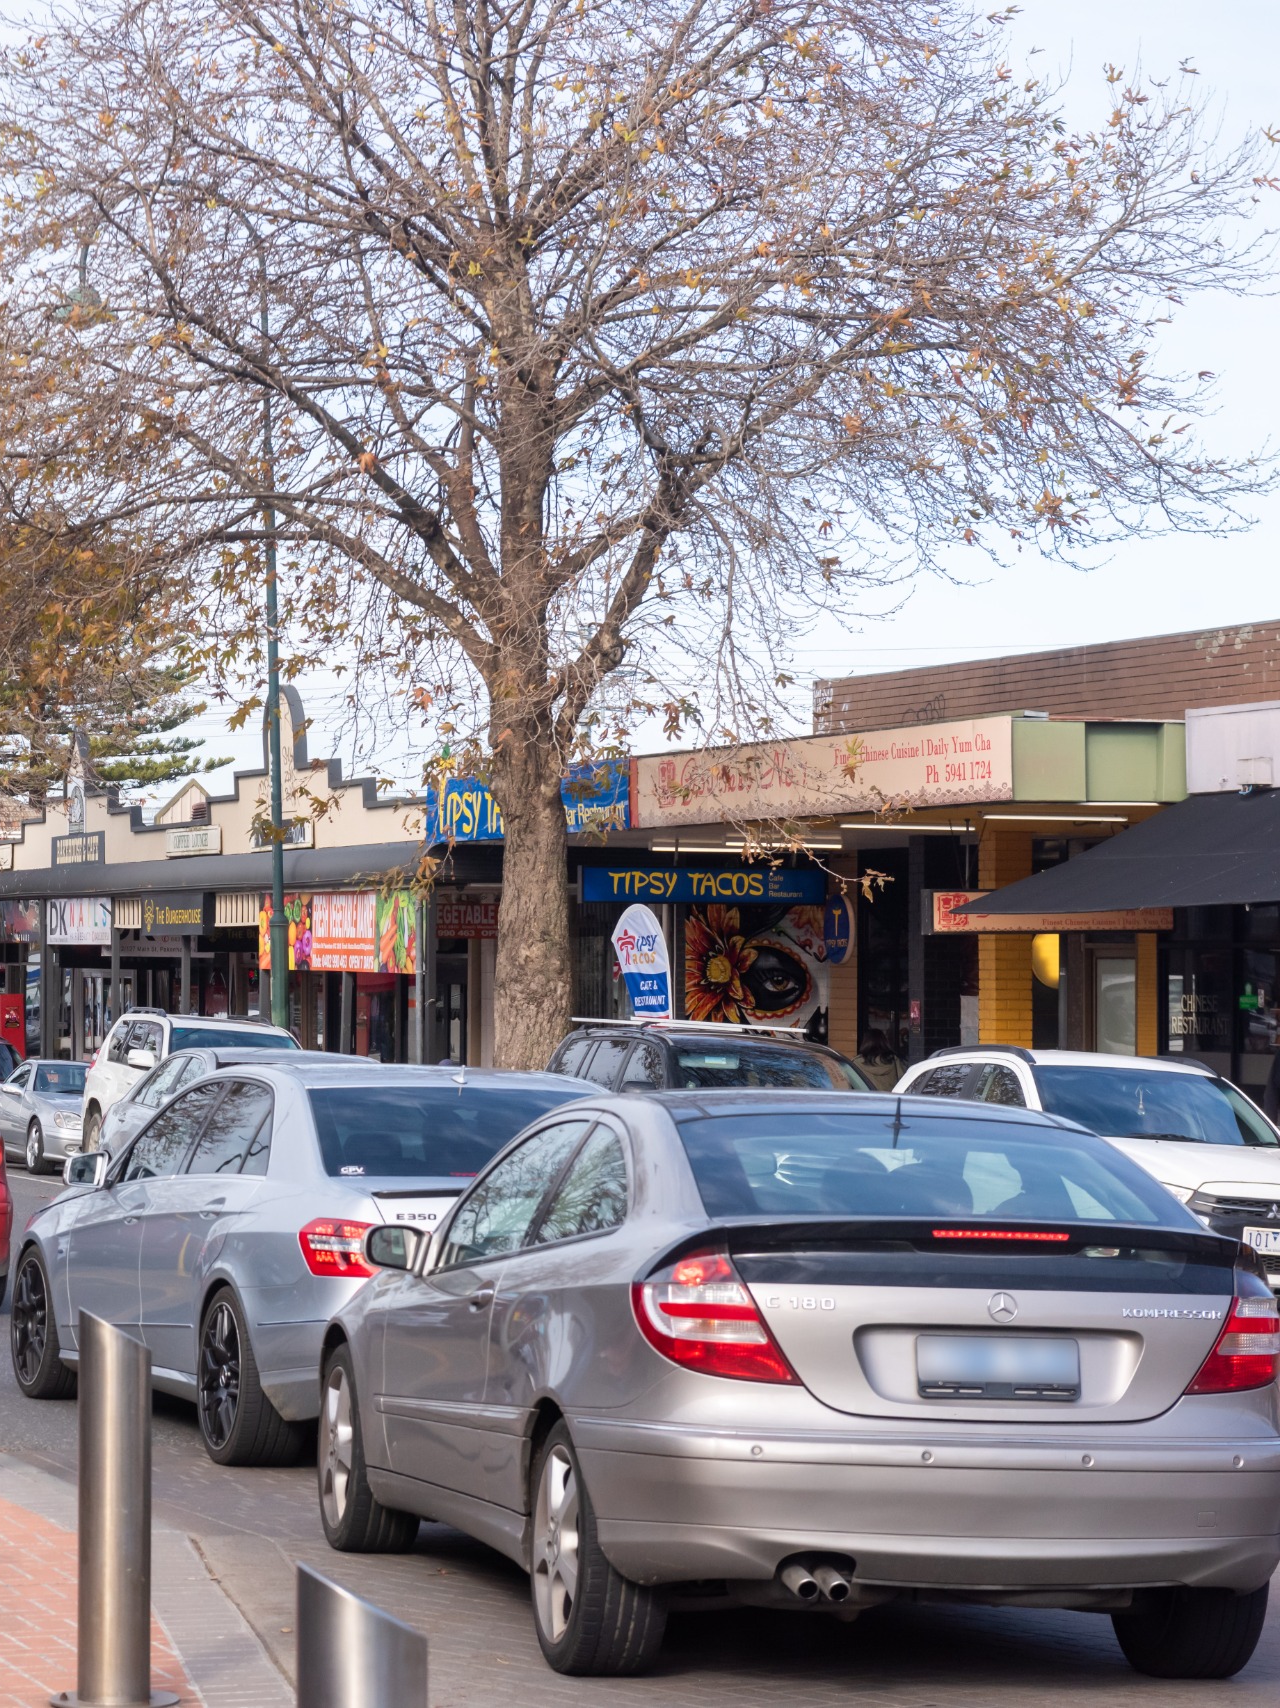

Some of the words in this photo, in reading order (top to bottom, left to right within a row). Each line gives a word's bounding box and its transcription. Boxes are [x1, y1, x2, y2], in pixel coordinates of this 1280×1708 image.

[891, 743, 919, 760] Cuisine
[927, 738, 949, 760] Daily
[952, 736, 972, 754] Yum
[975, 733, 991, 751] Cha
[926, 765, 939, 784] Ph
[945, 762, 967, 782] 5941
[970, 760, 992, 780] 1724
[608, 871, 677, 897] TIPSY
[687, 872, 763, 896] TACOS
[768, 890, 803, 898] Restaurant
[49, 900, 68, 935] DK
[436, 905, 495, 924] EGETABLE
[1181, 994, 1218, 1012] CHINESE
[1171, 1016, 1229, 1035] RESTAURANT
[1122, 1308, 1222, 1320] KOMPRESSOR
